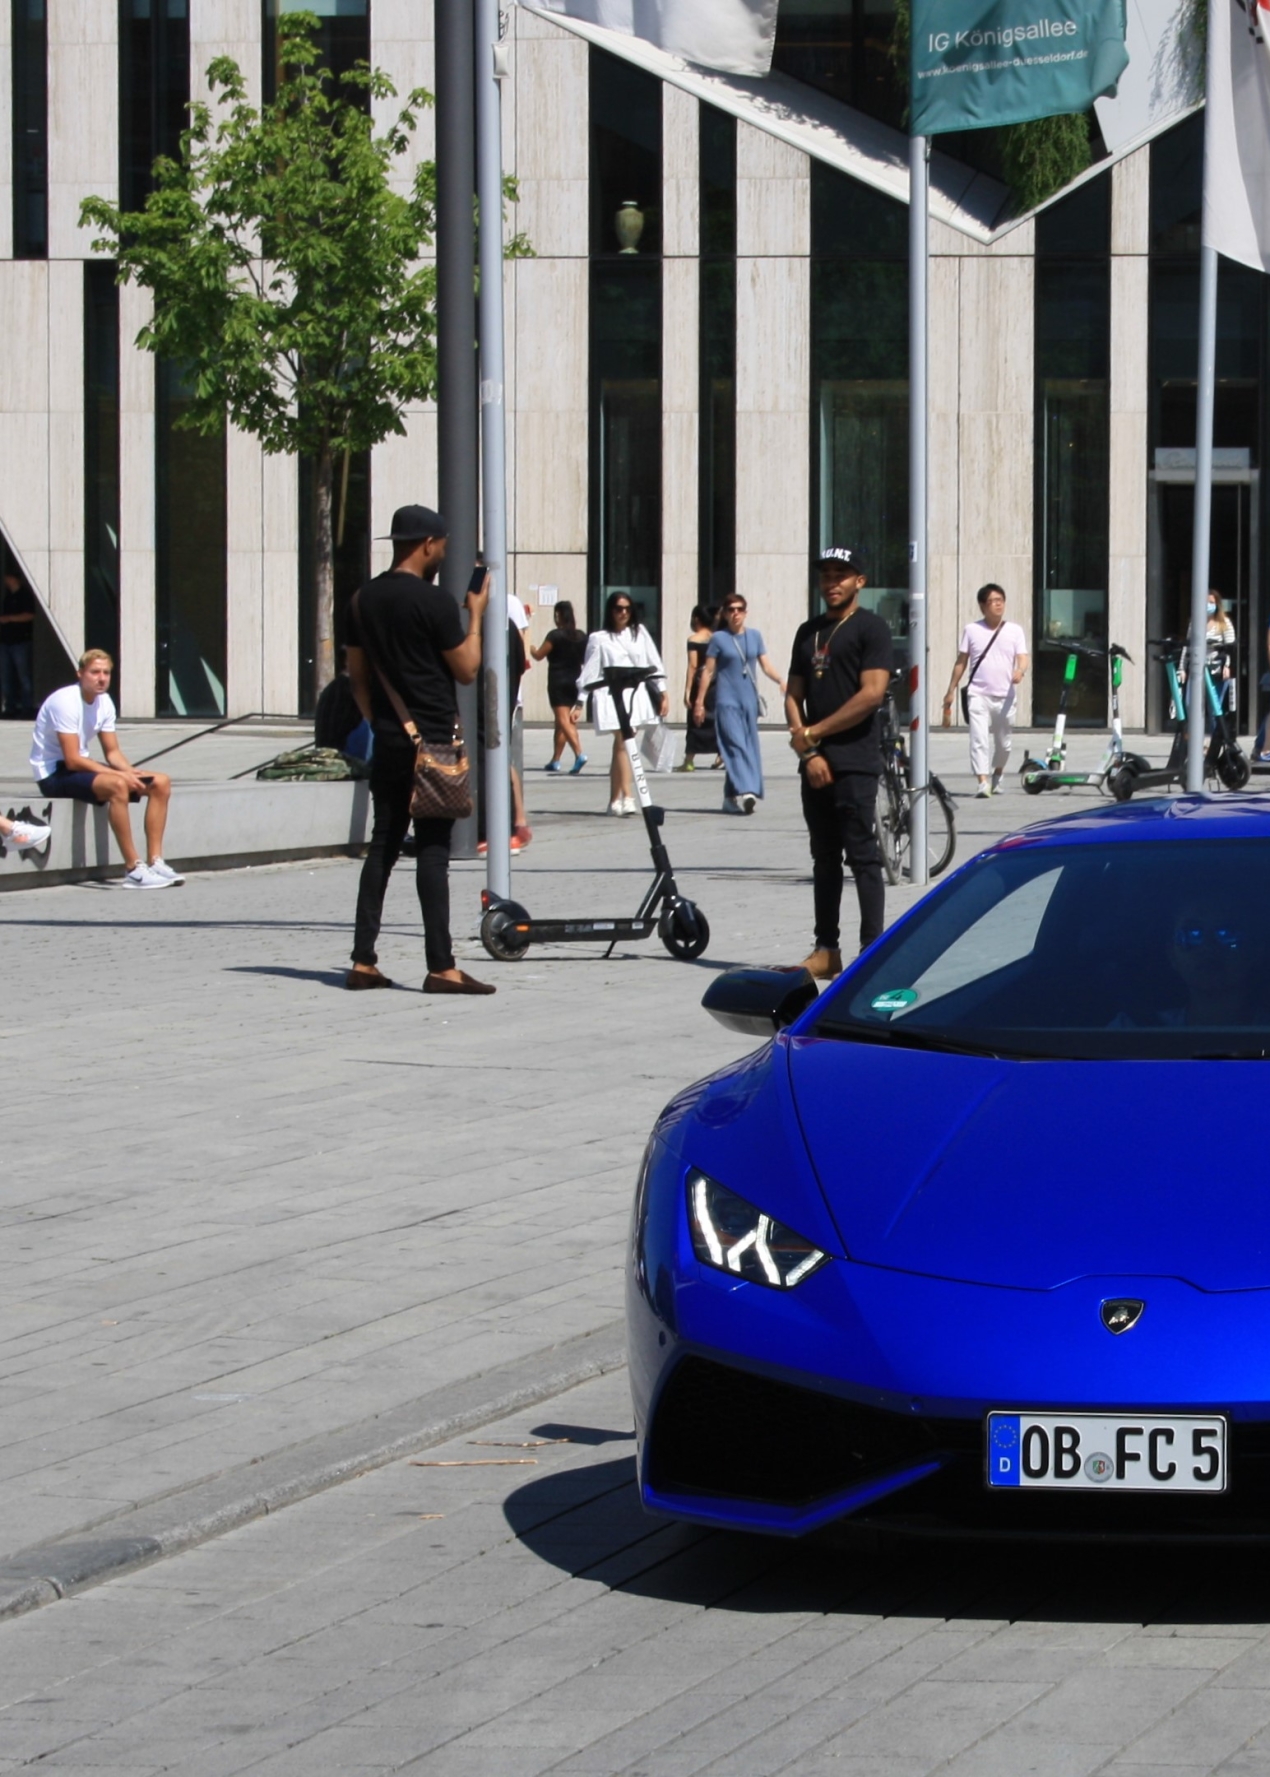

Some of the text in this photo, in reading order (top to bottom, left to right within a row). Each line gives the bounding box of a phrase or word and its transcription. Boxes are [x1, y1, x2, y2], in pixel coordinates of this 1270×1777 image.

[928, 19, 1077, 53] IG Königsallee
[631, 753, 649, 795] BIRD
[999, 1457, 1011, 1472] D
[1022, 1424, 1219, 1481] OB FC 5
